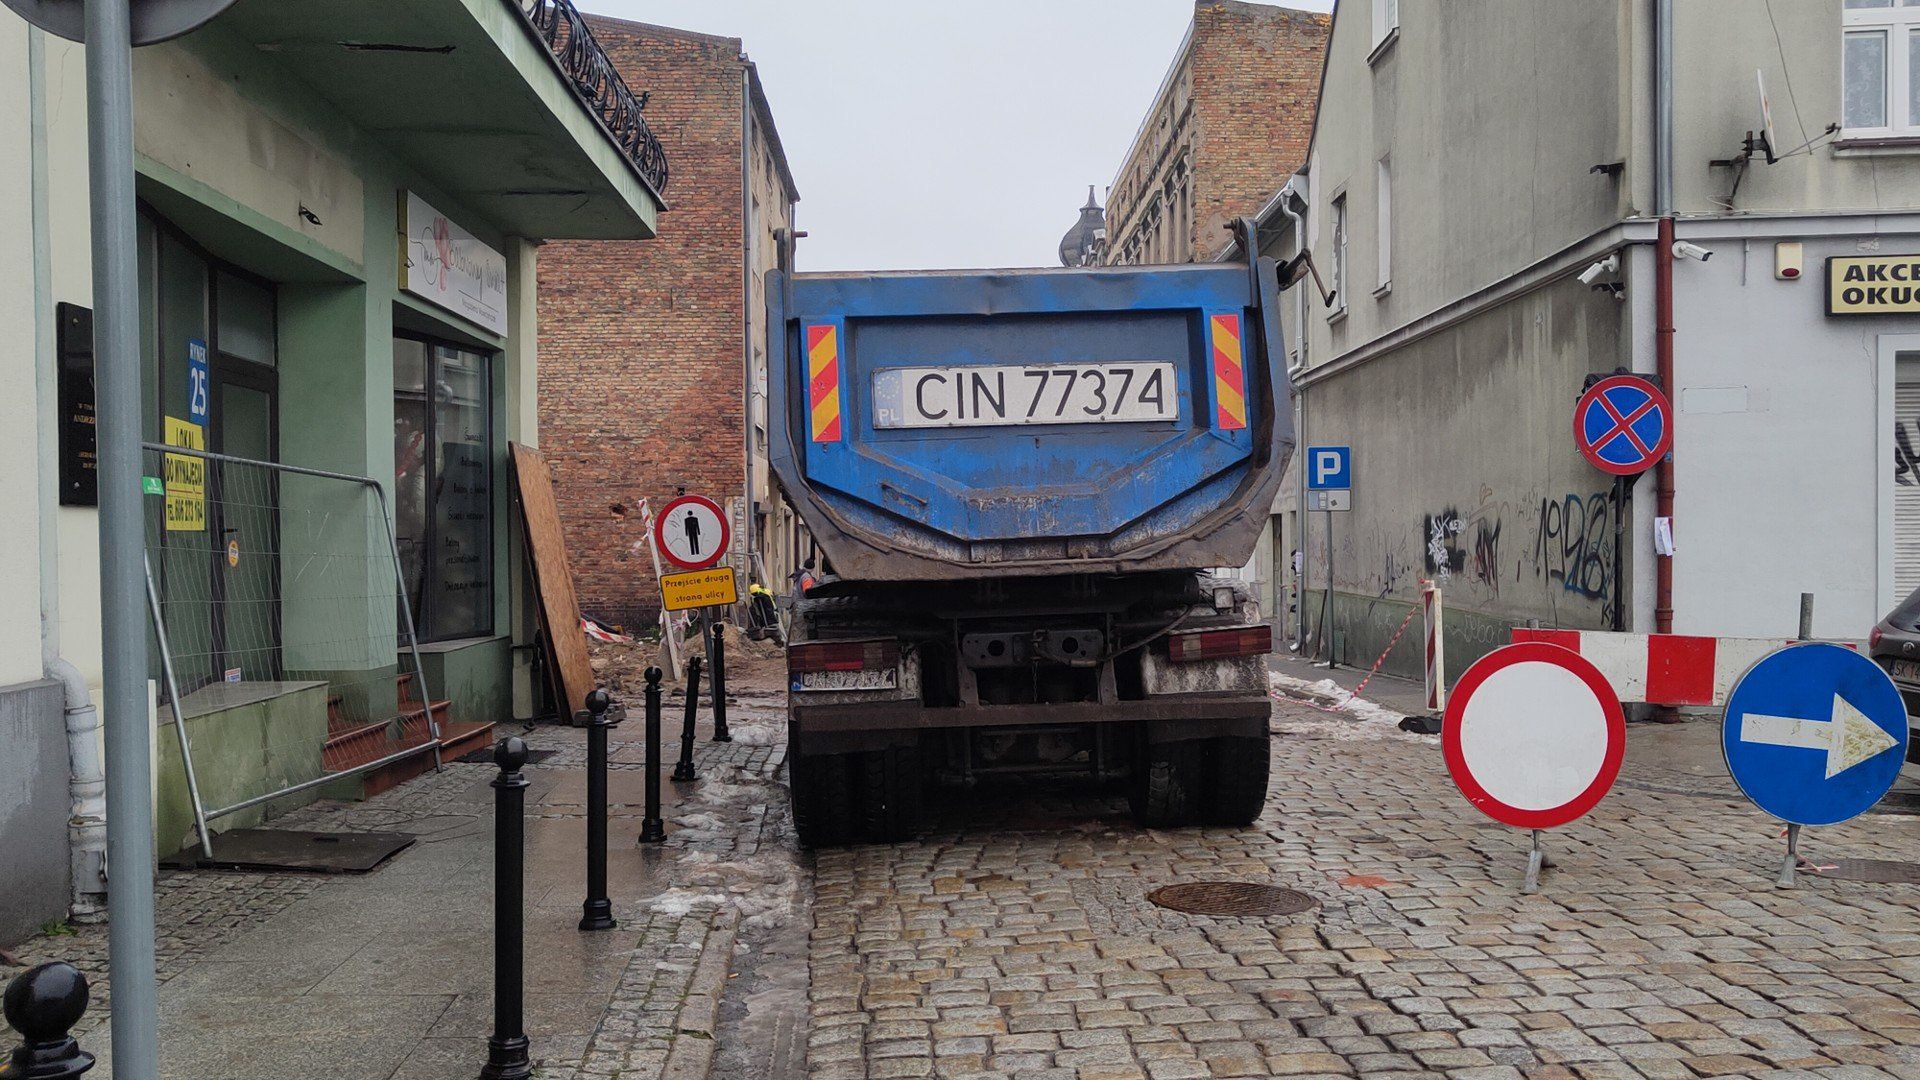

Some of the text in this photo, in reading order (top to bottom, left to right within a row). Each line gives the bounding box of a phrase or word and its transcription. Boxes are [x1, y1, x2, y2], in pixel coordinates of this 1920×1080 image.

[189, 342, 206, 364] RYNEK
[191, 367, 206, 416] 25
[916, 368, 1164, 420] CIN 77374
[878, 408, 900, 426] PL
[166, 457, 173, 482] DO
[1317, 452, 1341, 484] P
[705, 590, 725, 599] ulicy
